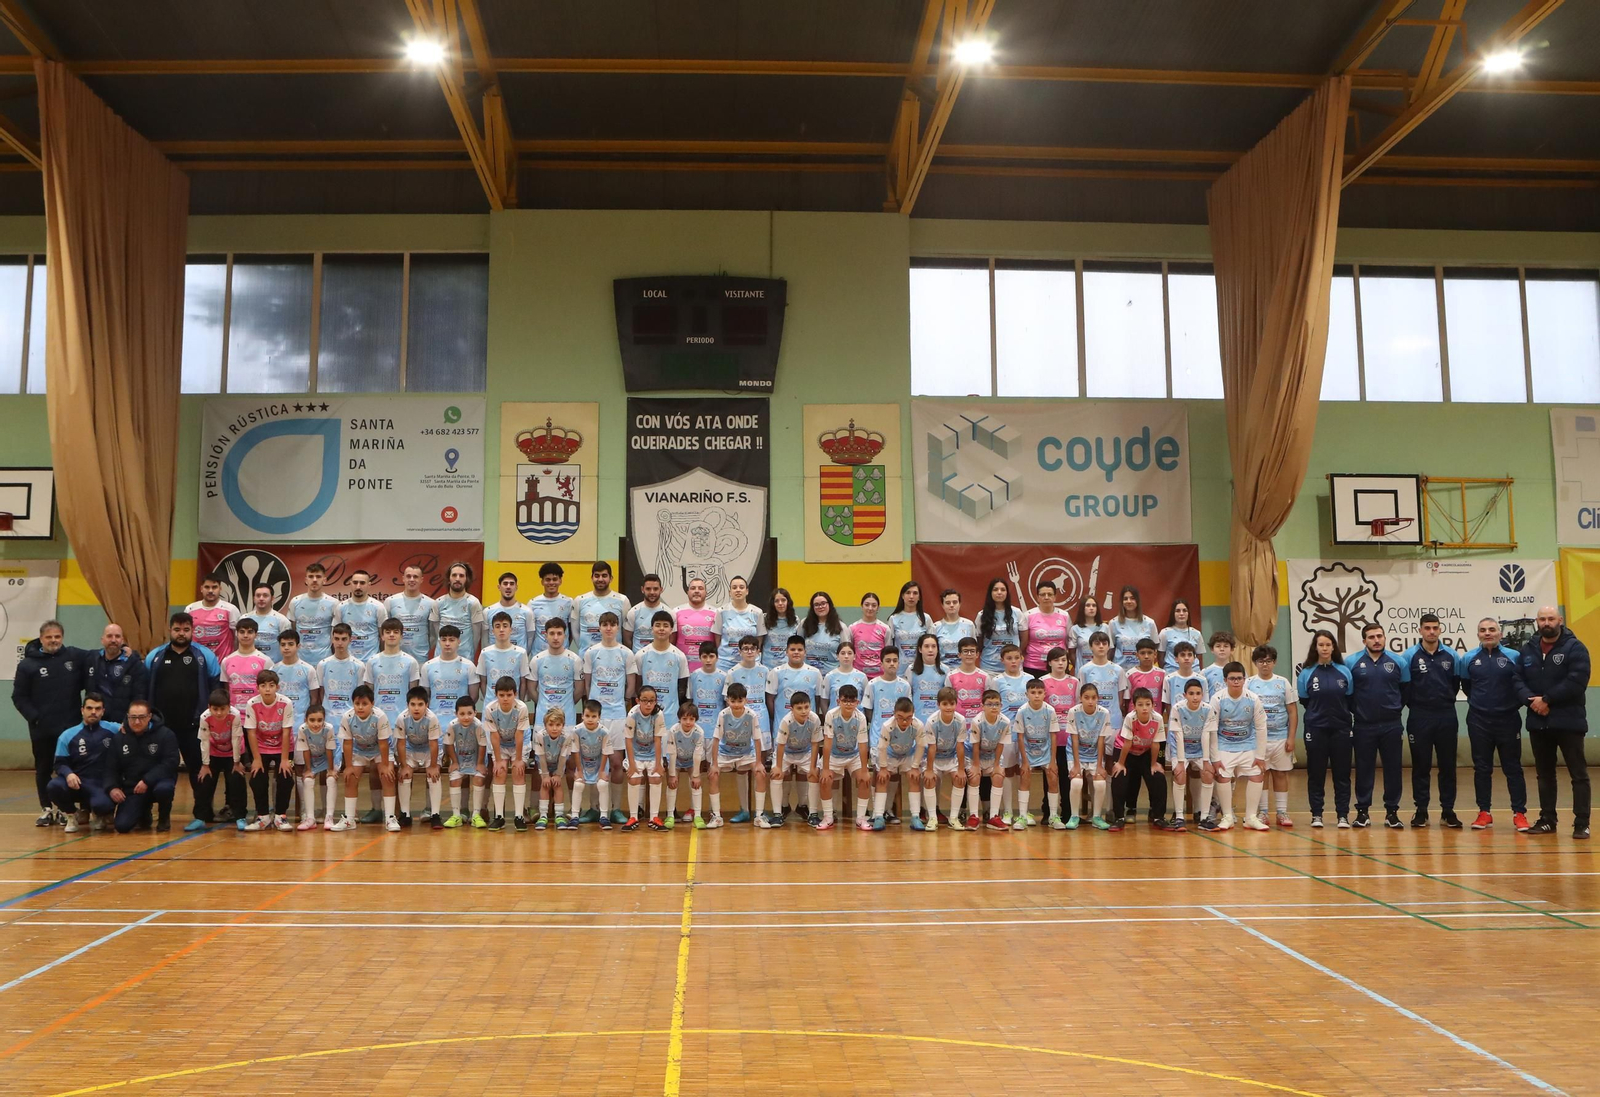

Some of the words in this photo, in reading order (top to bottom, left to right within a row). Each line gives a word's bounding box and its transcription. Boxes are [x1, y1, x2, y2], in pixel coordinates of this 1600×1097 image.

[643, 290, 667, 298] LOCAL
[725, 290, 765, 298] VISITANTE
[350, 418, 394, 430] SANTA
[635, 414, 661, 429] CON
[665, 412, 690, 429] VÓS
[695, 415, 722, 429] ATA
[726, 415, 759, 429] ONDE
[419, 428, 434, 436] +34
[435, 428, 450, 436] 682
[452, 428, 465, 436] 423
[467, 427, 480, 435] 577
[349, 436, 405, 450] MARIÑA
[631, 435, 700, 450] QUEIRADES
[704, 436, 752, 450] CHEGAR
[205, 434, 231, 498] PENSIÓN
[228, 403, 289, 435] RÚSTICA
[1037, 426, 1180, 482] coyde
[349, 458, 367, 470] DA
[348, 478, 393, 490] PONTE
[644, 489, 723, 504] VIANARIÑO
[726, 492, 751, 504] F.S.
[1064, 494, 1158, 518] GROUP
[1492, 596, 1507, 604] NEW
[1507, 596, 1535, 604] HOLLAND
